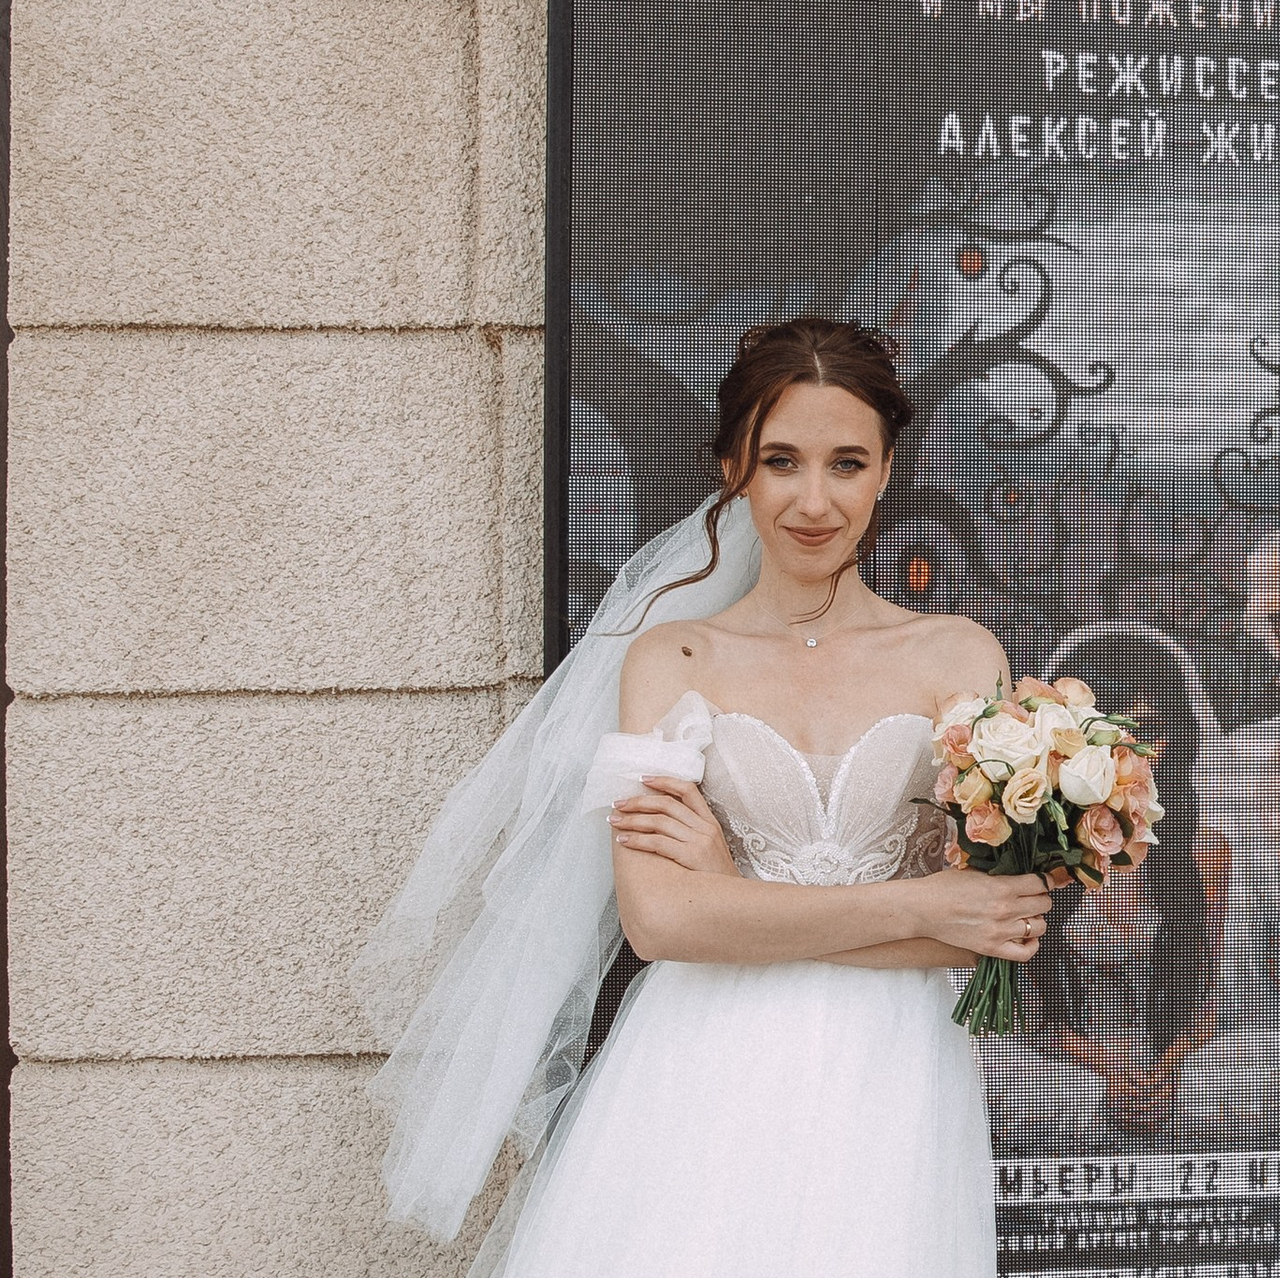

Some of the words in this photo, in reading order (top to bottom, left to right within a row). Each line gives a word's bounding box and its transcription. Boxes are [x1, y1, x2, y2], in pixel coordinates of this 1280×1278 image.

[937, 108, 1167, 163] АЛЕКСЕЙ
[999, 1162, 1152, 1199] МЬЕРЫ:
[1178, 1159, 1223, 1195] 22
